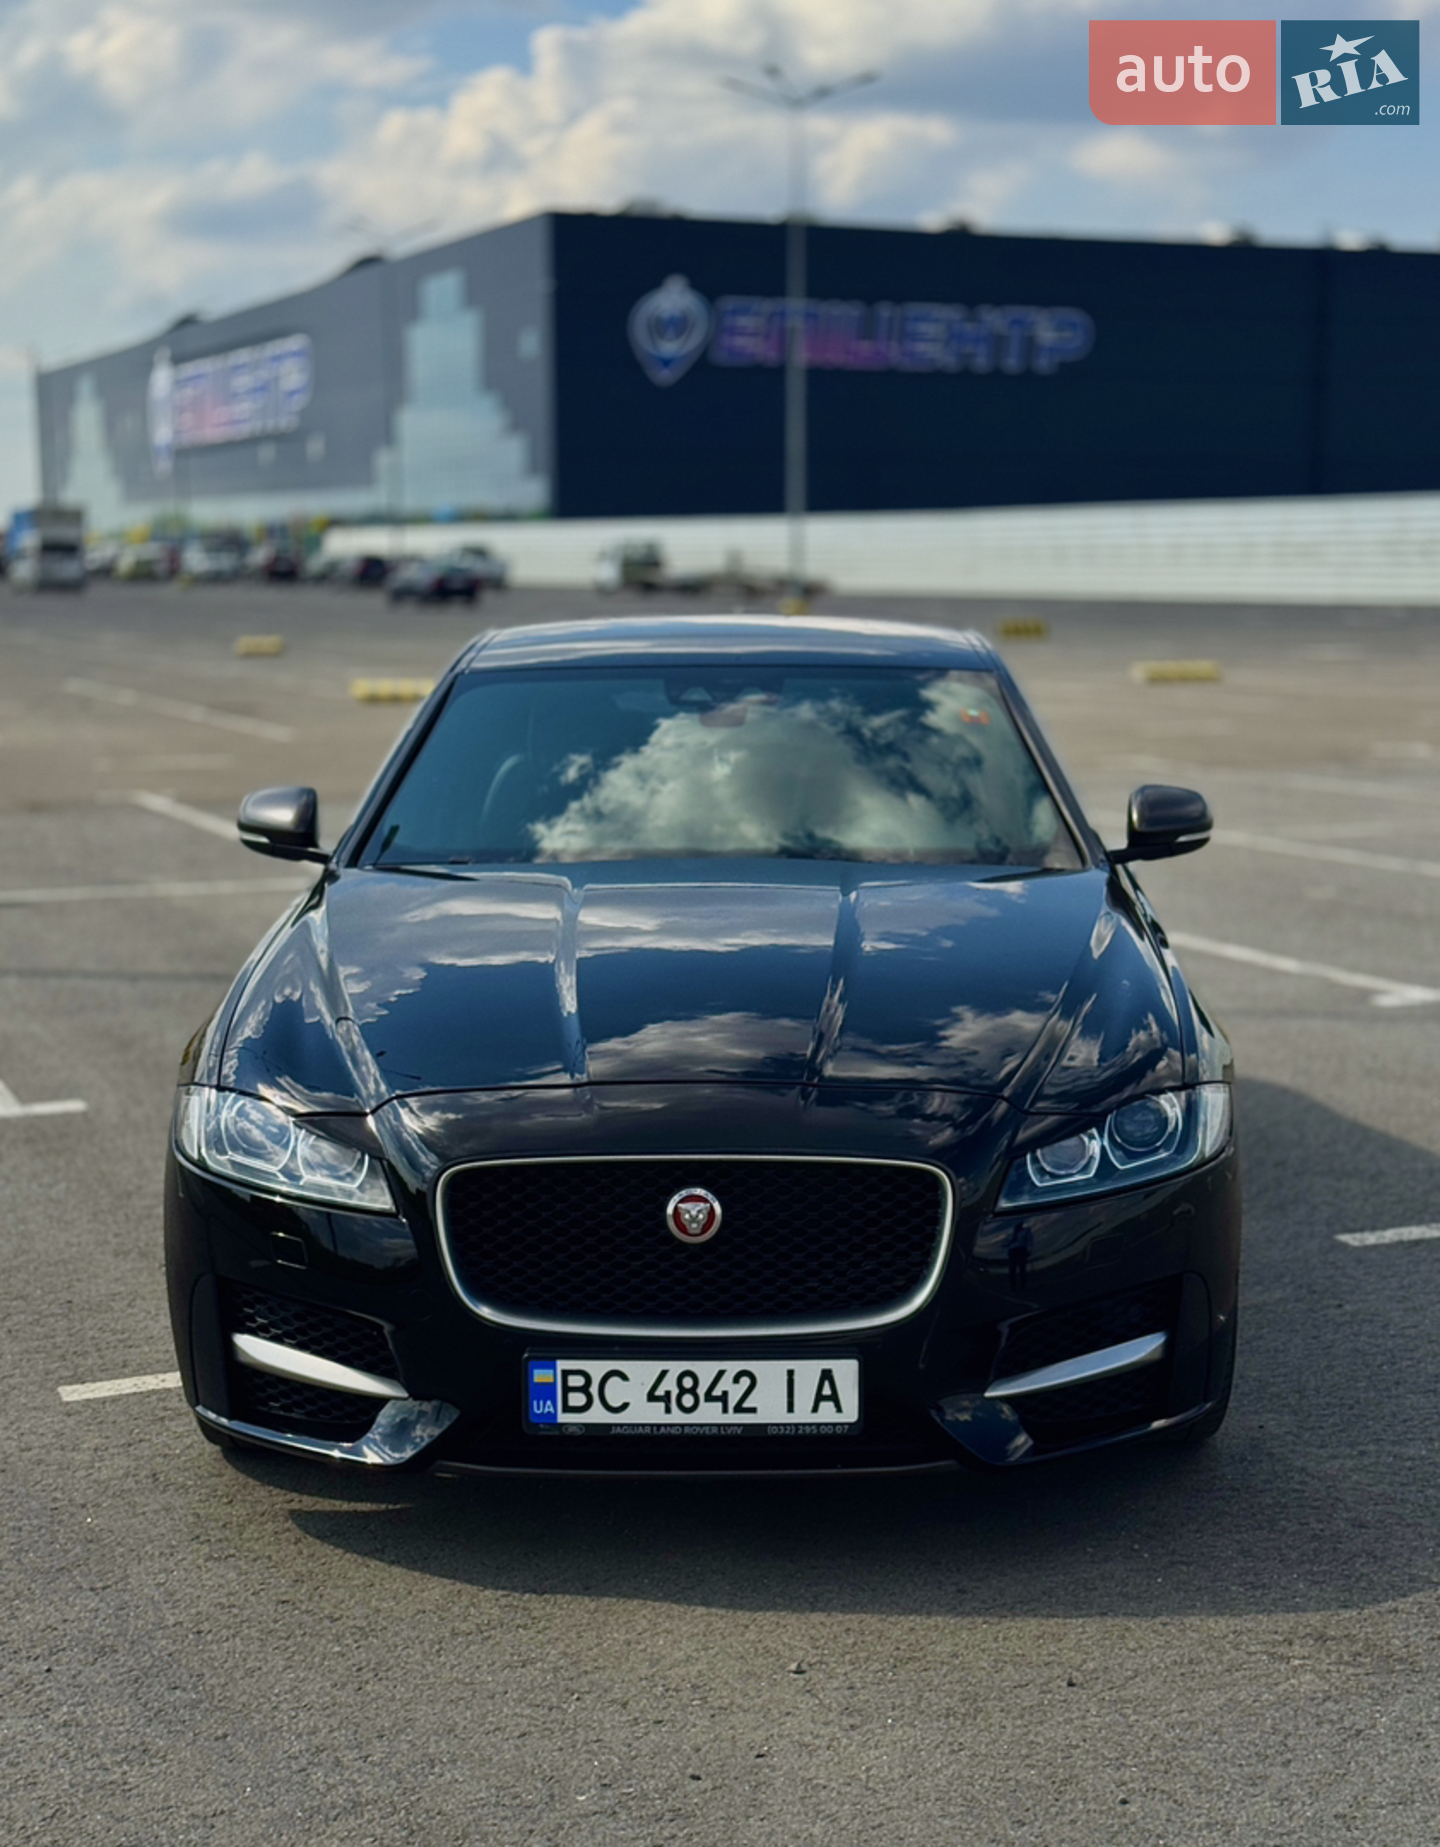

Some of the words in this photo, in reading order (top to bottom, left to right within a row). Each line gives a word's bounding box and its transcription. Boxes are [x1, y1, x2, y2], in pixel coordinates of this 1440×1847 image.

[561, 1369, 631, 1414] BC
[646, 1369, 758, 1414] 4842
[533, 1400, 555, 1414] UA
[610, 1425, 650, 1435] JAGUAR
[653, 1425, 682, 1435] LAND
[684, 1425, 719, 1435] ROVER
[721, 1425, 743, 1435] LVIV
[767, 1424, 796, 1435] (032)
